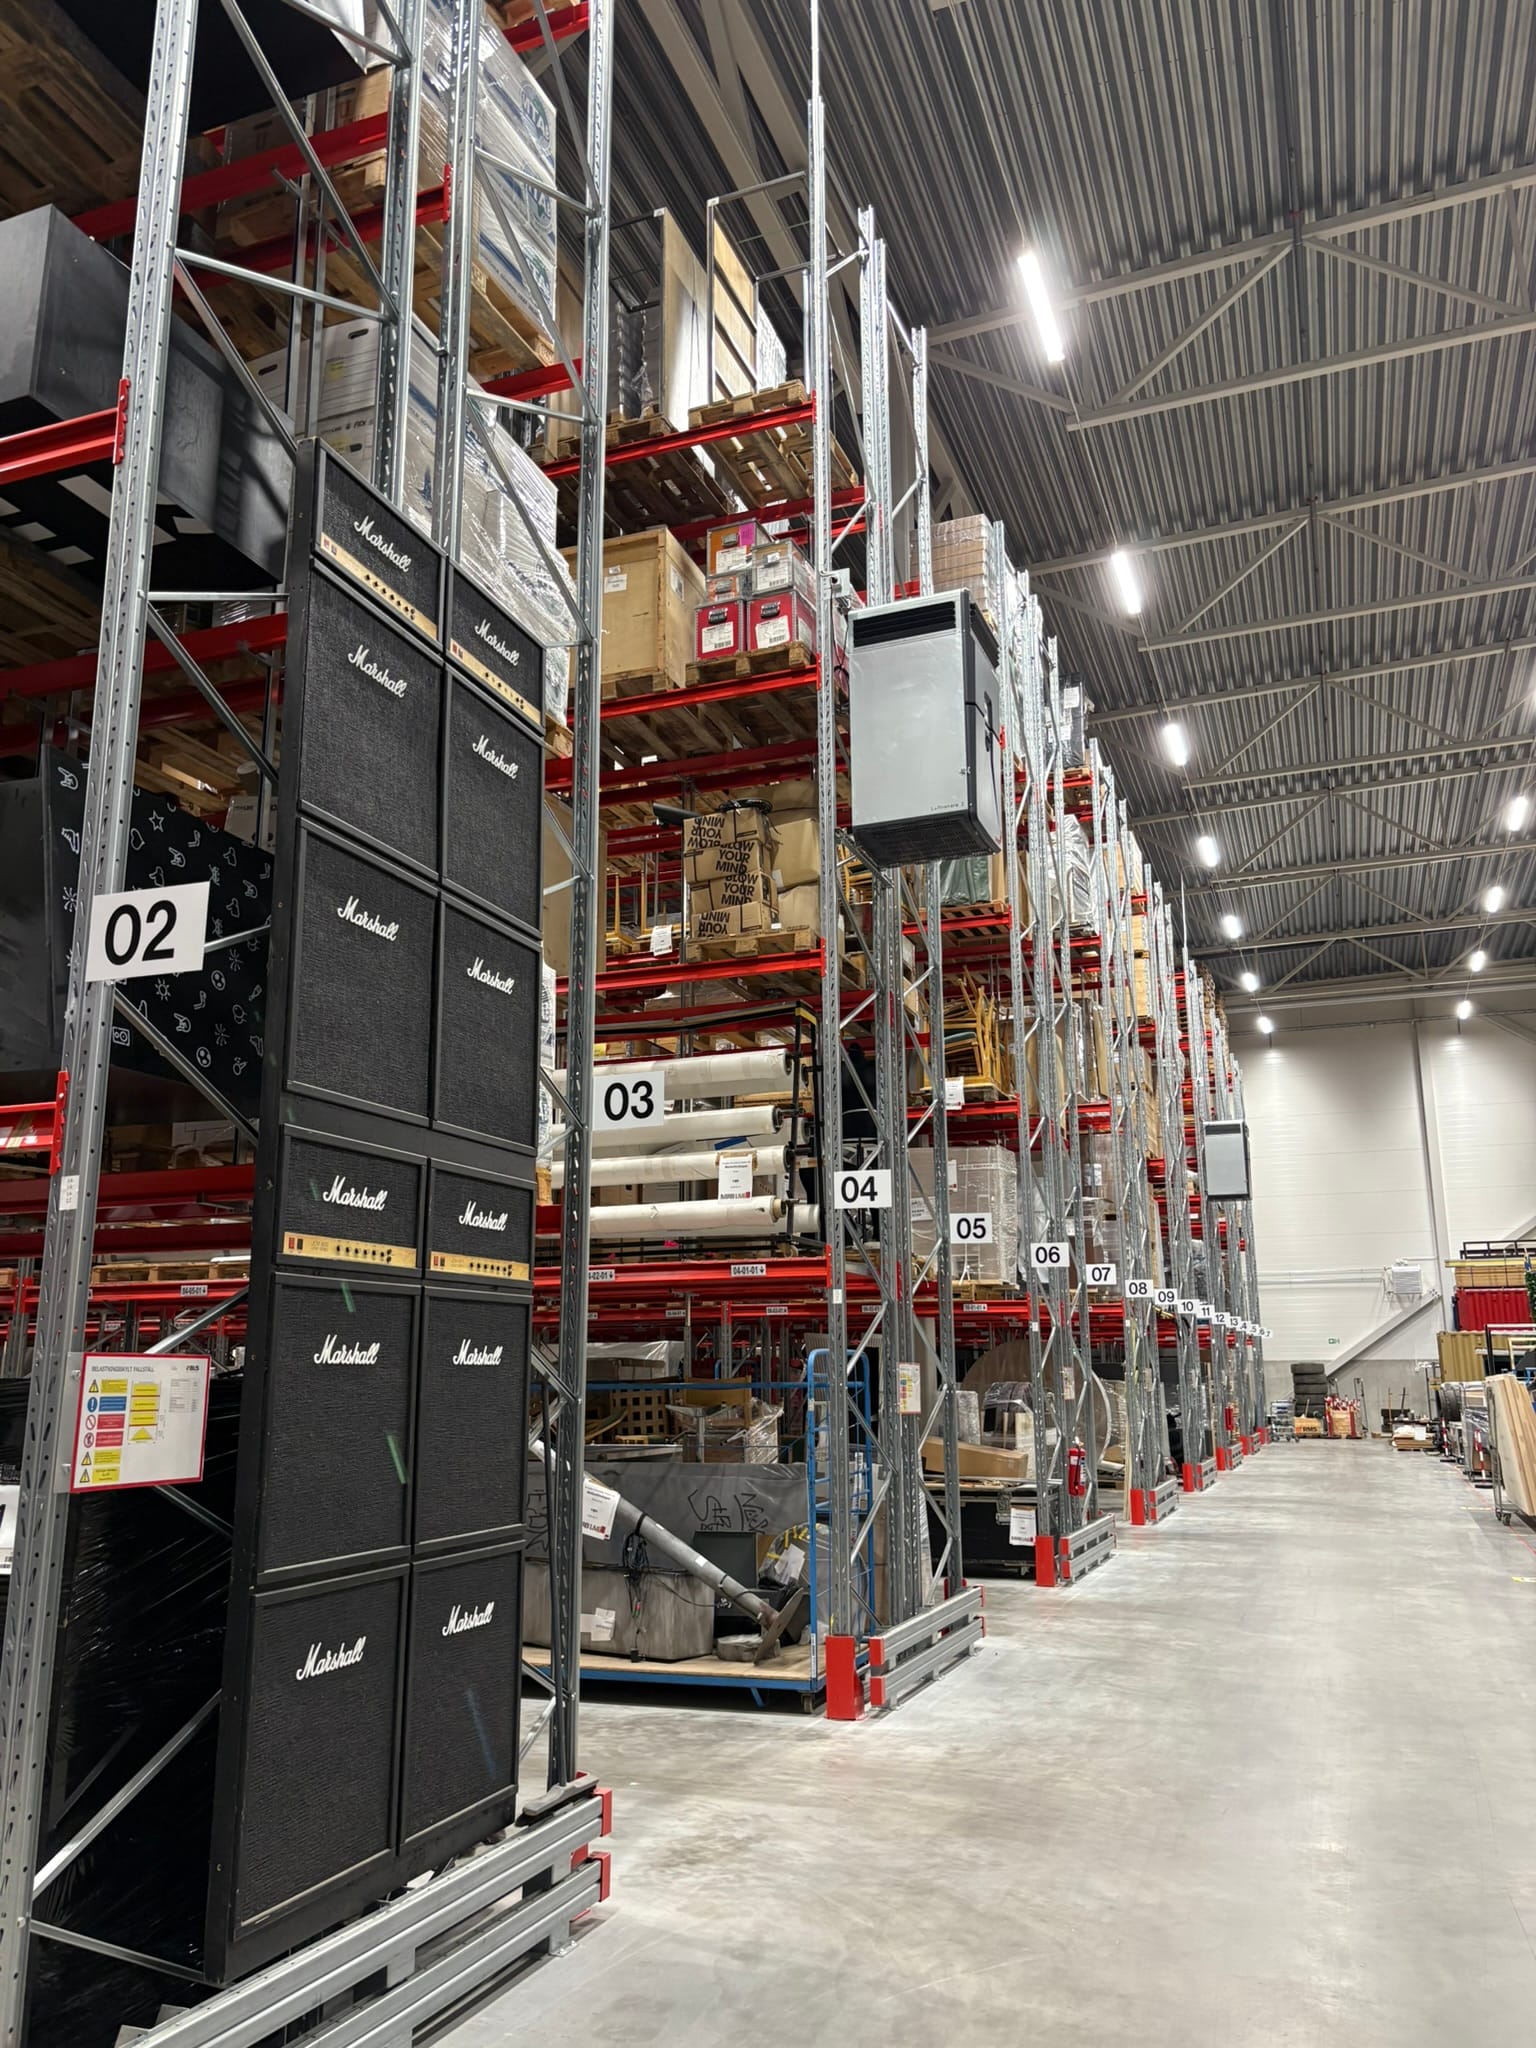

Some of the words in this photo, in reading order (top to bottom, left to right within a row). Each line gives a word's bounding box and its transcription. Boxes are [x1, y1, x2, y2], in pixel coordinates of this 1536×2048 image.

[353, 515, 412, 572] Marshall
[474, 619, 520, 666] Marshall
[347, 645, 408, 698] Marshall
[472, 734, 519, 780] Marshall
[691, 825, 722, 839] YOUR
[715, 861, 748, 875] MIND
[720, 849, 751, 864] YOUR
[724, 882, 755, 897] YOUR
[337, 896, 400, 942] Marshall
[699, 921, 728, 935] YOUR
[105, 900, 177, 966] 02
[467, 957, 515, 995] Marshall
[604, 1080, 654, 1122] 03
[322, 1175, 389, 1211] Marshall
[841, 1176, 878, 1203] 04
[458, 1201, 508, 1232] Marshall
[956, 1218, 987, 1240] 05
[1036, 1246, 1060, 1264] 06
[733, 1265, 759, 1275] 04-01-01
[1092, 1267, 1111, 1282] 07
[1129, 1282, 1148, 1295] 08
[1158, 1291, 1175, 1302] 09
[1182, 1301, 1194, 1311] 10
[1202, 1306, 1210, 1316] 11
[1215, 1314, 1225, 1323] 12
[1231, 1318, 1239, 1326] 13
[314, 1334, 381, 1365] Marshall
[452, 1339, 503, 1366] Marshall
[441, 1602, 494, 1637] Marshall
[296, 1636, 367, 1681] Marshall
